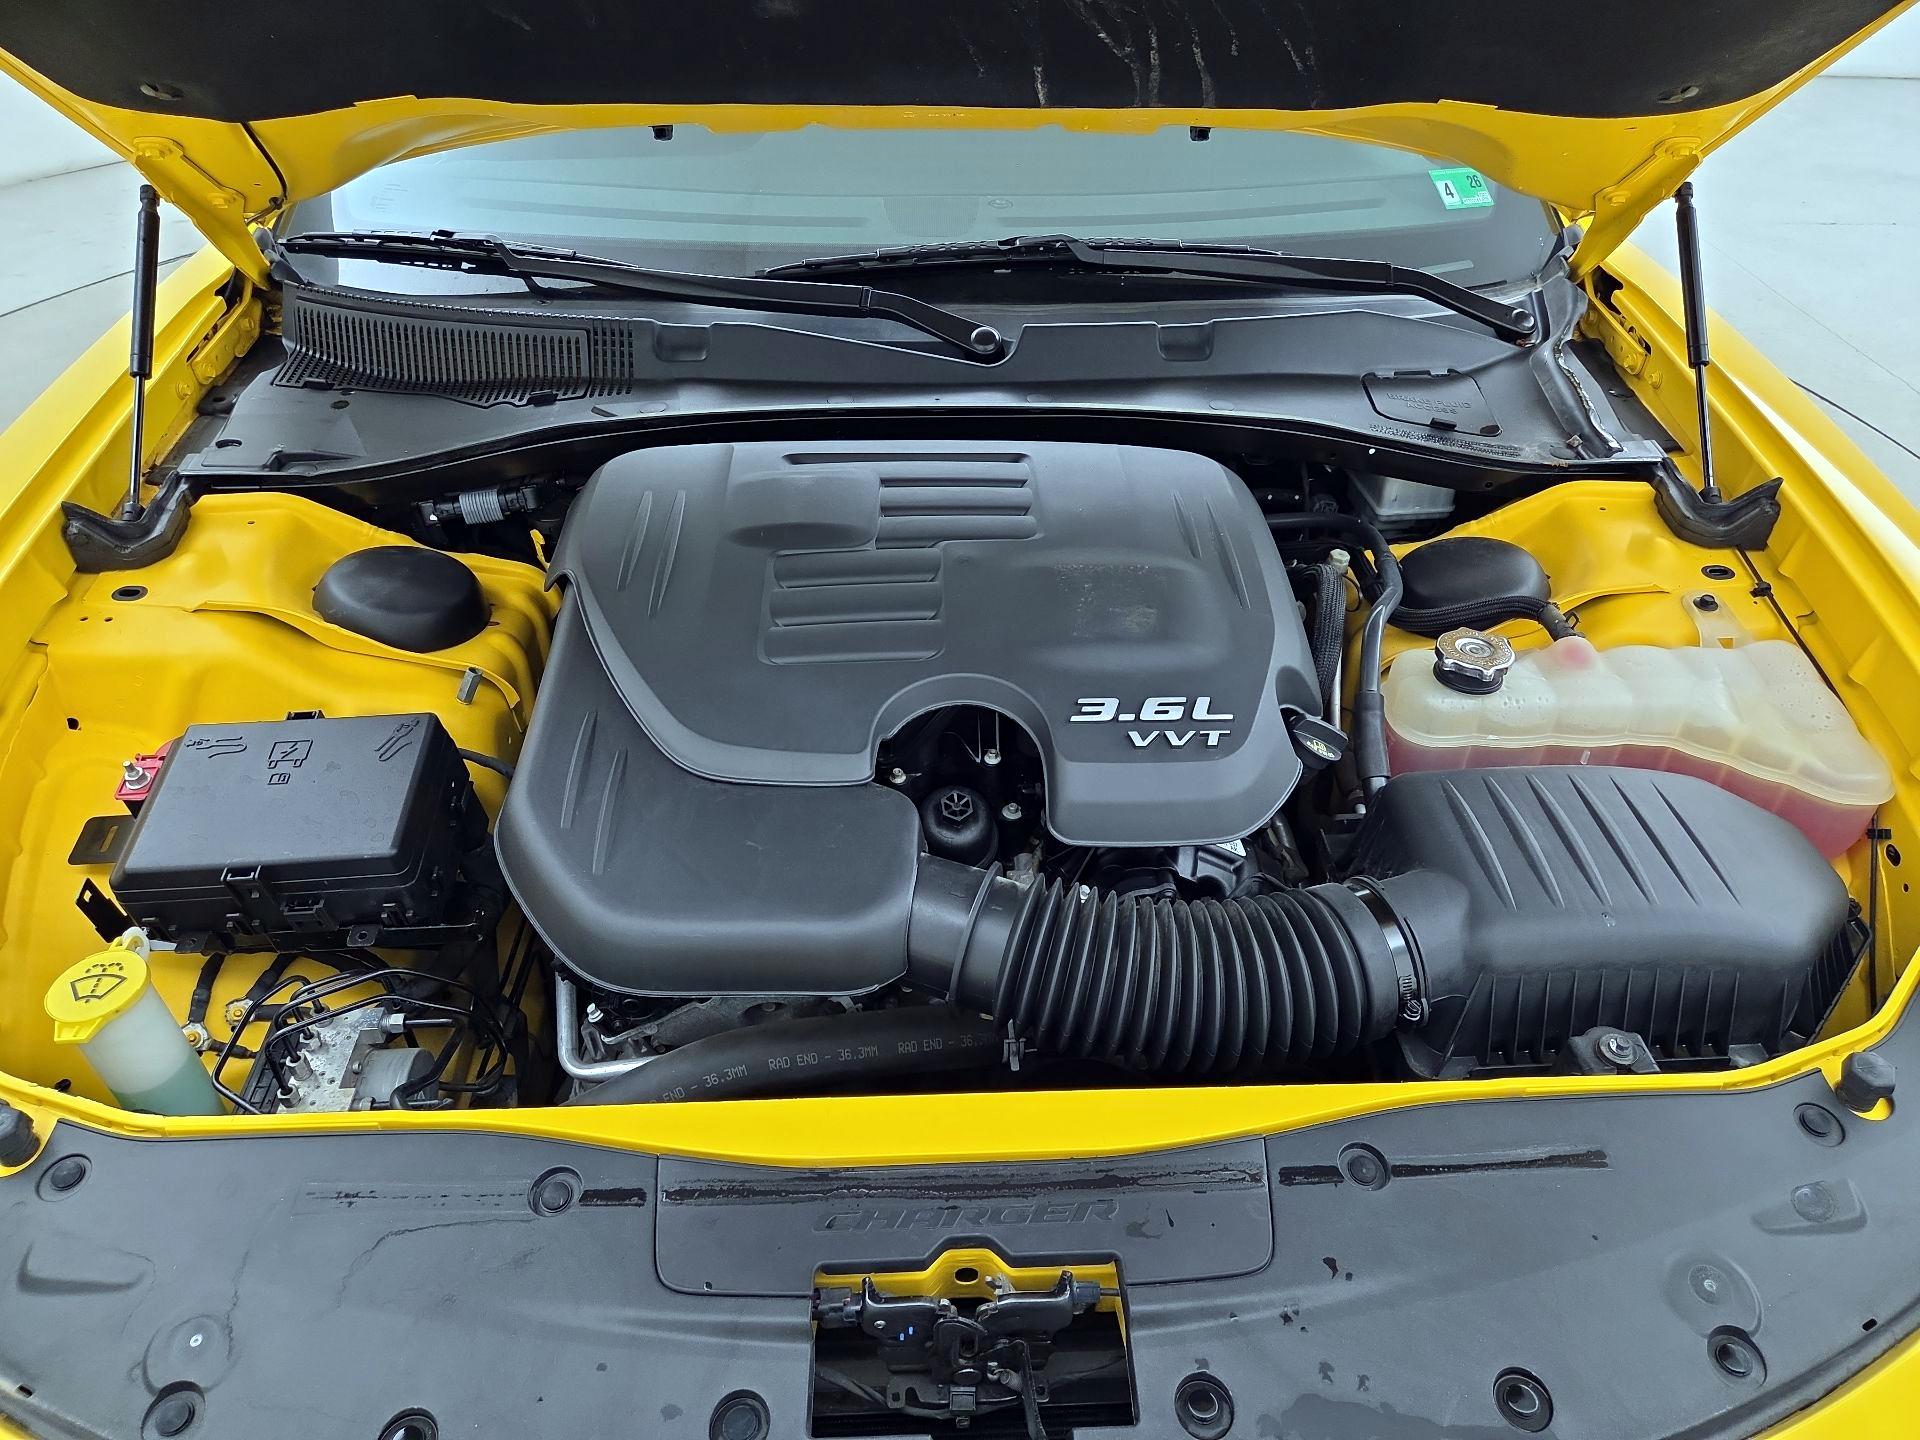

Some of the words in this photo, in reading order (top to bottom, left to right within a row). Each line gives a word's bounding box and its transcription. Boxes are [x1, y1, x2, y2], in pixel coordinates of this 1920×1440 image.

[1445, 183, 1454, 198] 4
[1466, 175, 1482, 188] 26
[1069, 697, 1234, 723] 3.6L
[1127, 730, 1231, 748] VVT
[898, 1041, 918, 1055] RAD
[923, 1038, 943, 1051] END
[768, 1056, 791, 1071] RAD
[796, 1053, 818, 1066] END
[838, 1045, 878, 1061] 36.3MM
[702, 1065, 748, 1088] 36.3MM
[812, 1200, 1120, 1232] CHARGER
